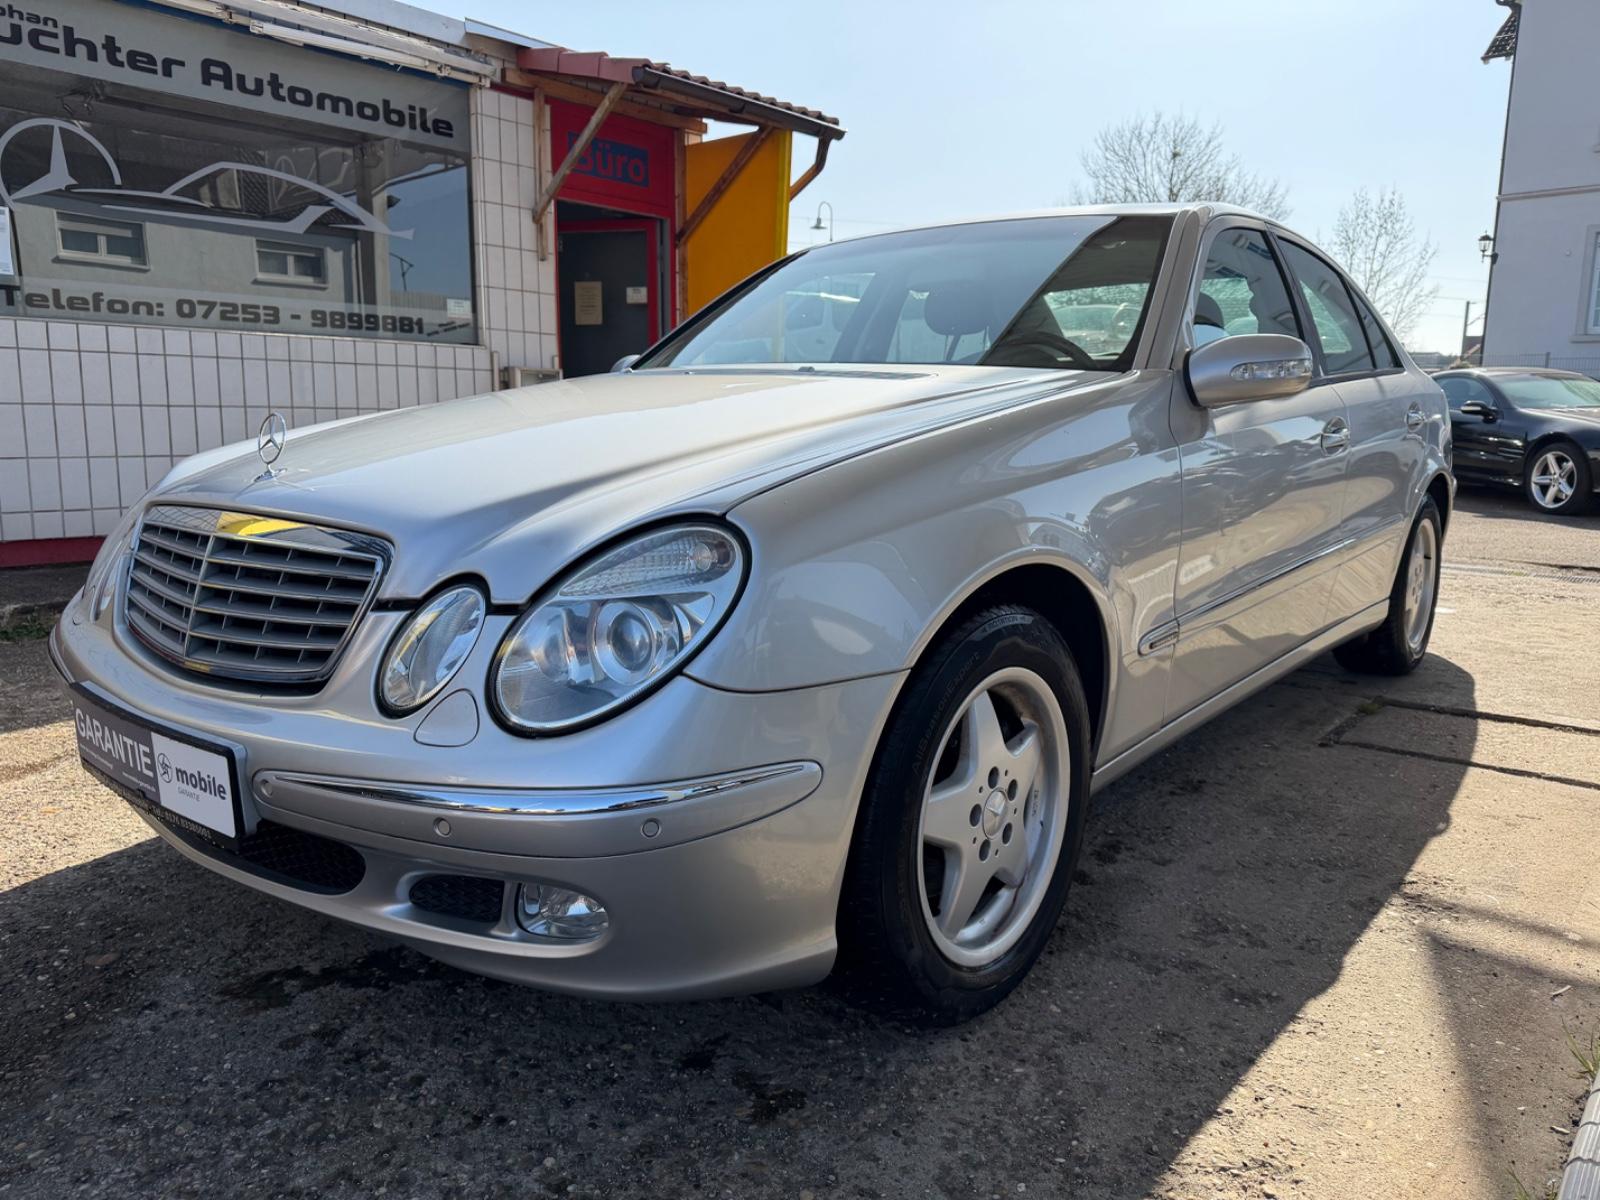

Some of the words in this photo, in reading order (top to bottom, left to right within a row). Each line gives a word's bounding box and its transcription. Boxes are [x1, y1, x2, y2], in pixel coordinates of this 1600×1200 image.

[201, 58, 454, 137] Automobile
[0, 285, 165, 317] Telefon:
[176, 298, 280, 324] 07253
[311, 309, 424, 334] 9899881
[75, 707, 155, 779] GARANTIE
[175, 765, 227, 800] mobile
